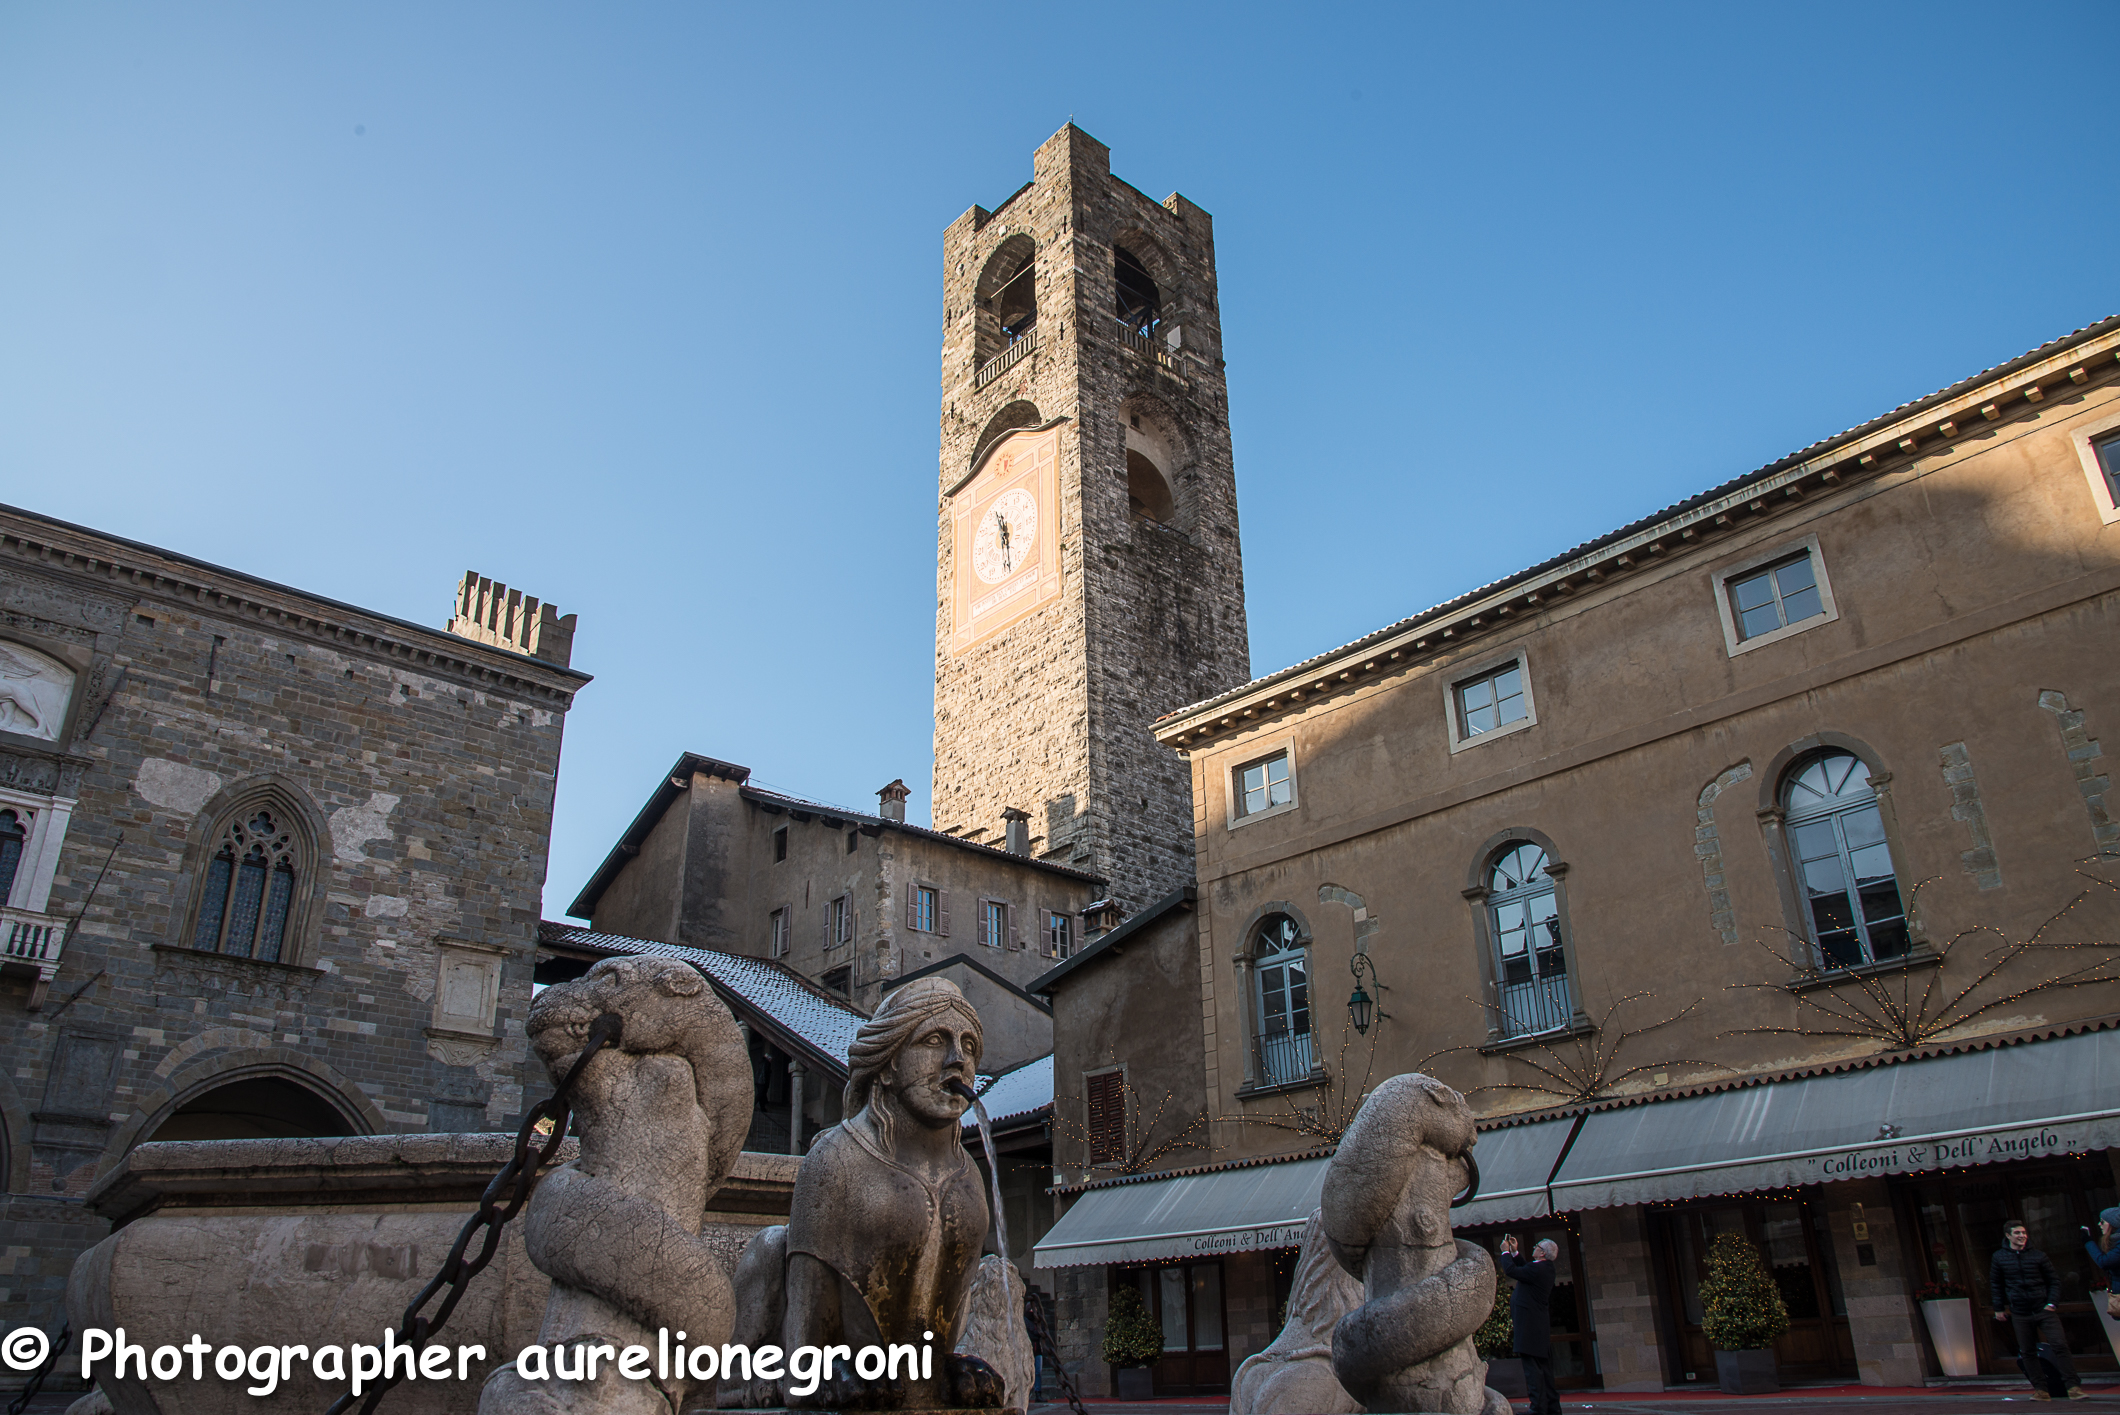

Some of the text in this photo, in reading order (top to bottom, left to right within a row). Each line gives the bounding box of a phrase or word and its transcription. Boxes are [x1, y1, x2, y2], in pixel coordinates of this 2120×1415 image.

[1822, 1150, 1899, 1174] Colleoni
[1907, 1146, 1927, 1164] &
[1194, 1234, 1237, 1250] Colleoni
[1240, 1232, 1253, 1246] &
